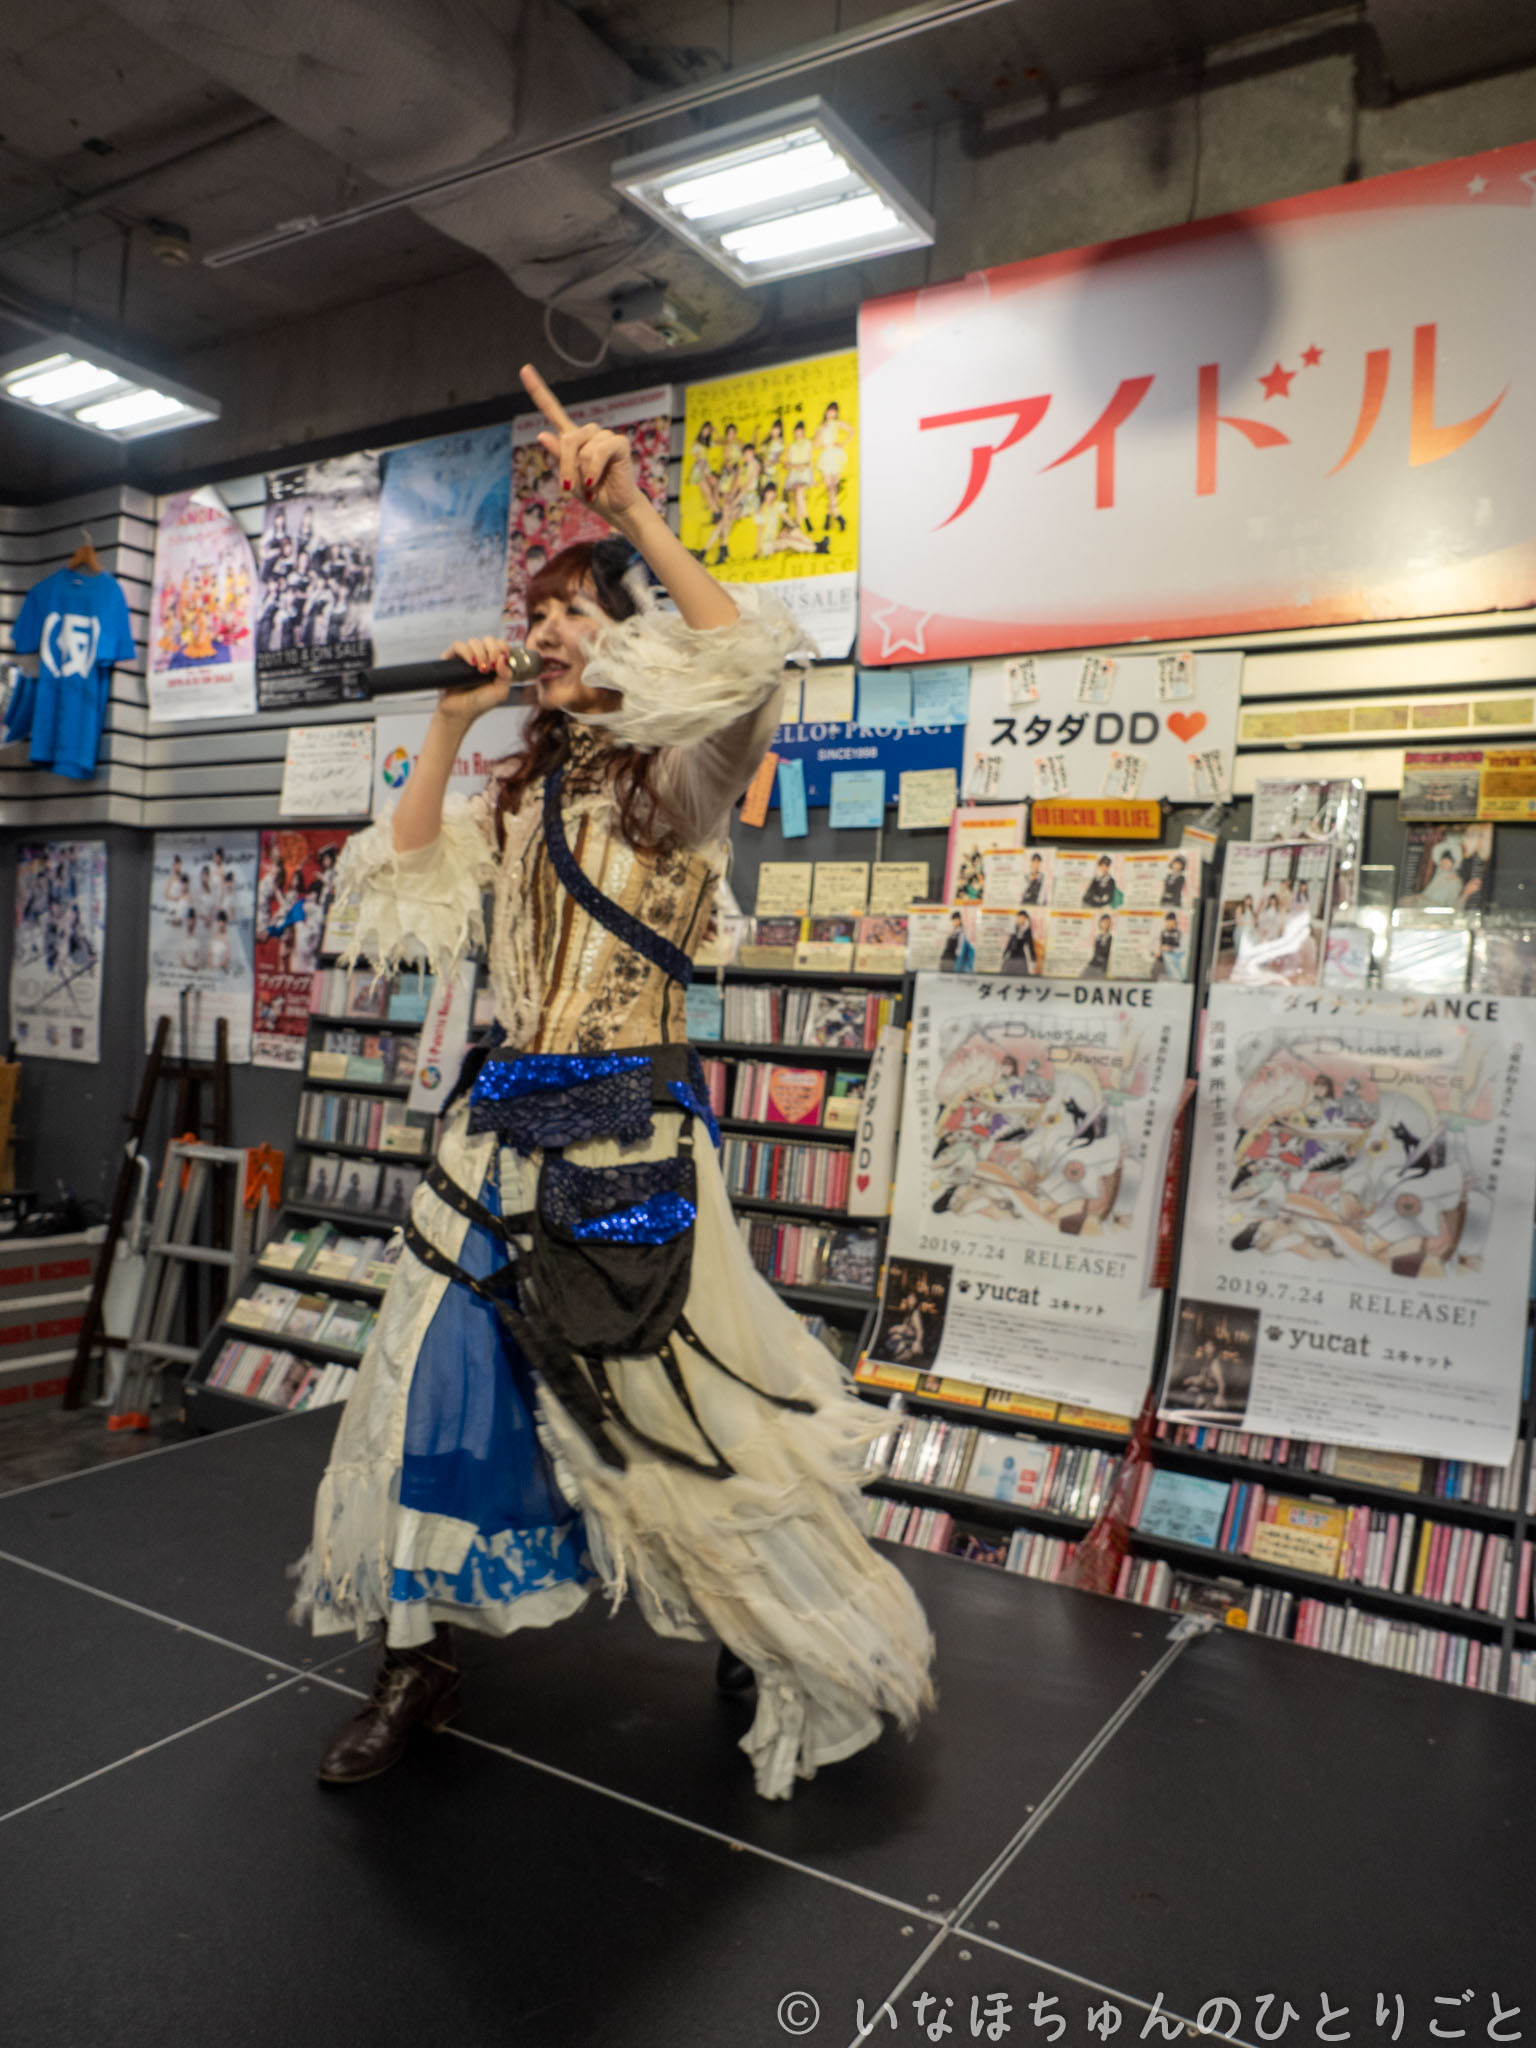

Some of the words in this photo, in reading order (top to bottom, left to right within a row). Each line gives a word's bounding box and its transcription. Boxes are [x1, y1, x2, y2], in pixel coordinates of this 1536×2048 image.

[919, 322, 1511, 533] アイドル
[990, 710, 1160, 748] スタダDD
[978, 982, 1154, 1008] ダイナソーDANCE
[918, 1234, 1007, 1262] 2019.7.24
[1023, 1247, 1128, 1280] RELEASE!
[975, 1279, 1041, 1308] yucat
[1216, 1273, 1326, 1307] 2019.7.24
[1348, 1290, 1478, 1329] RELEASE!
[1289, 1325, 1371, 1359] yucat
